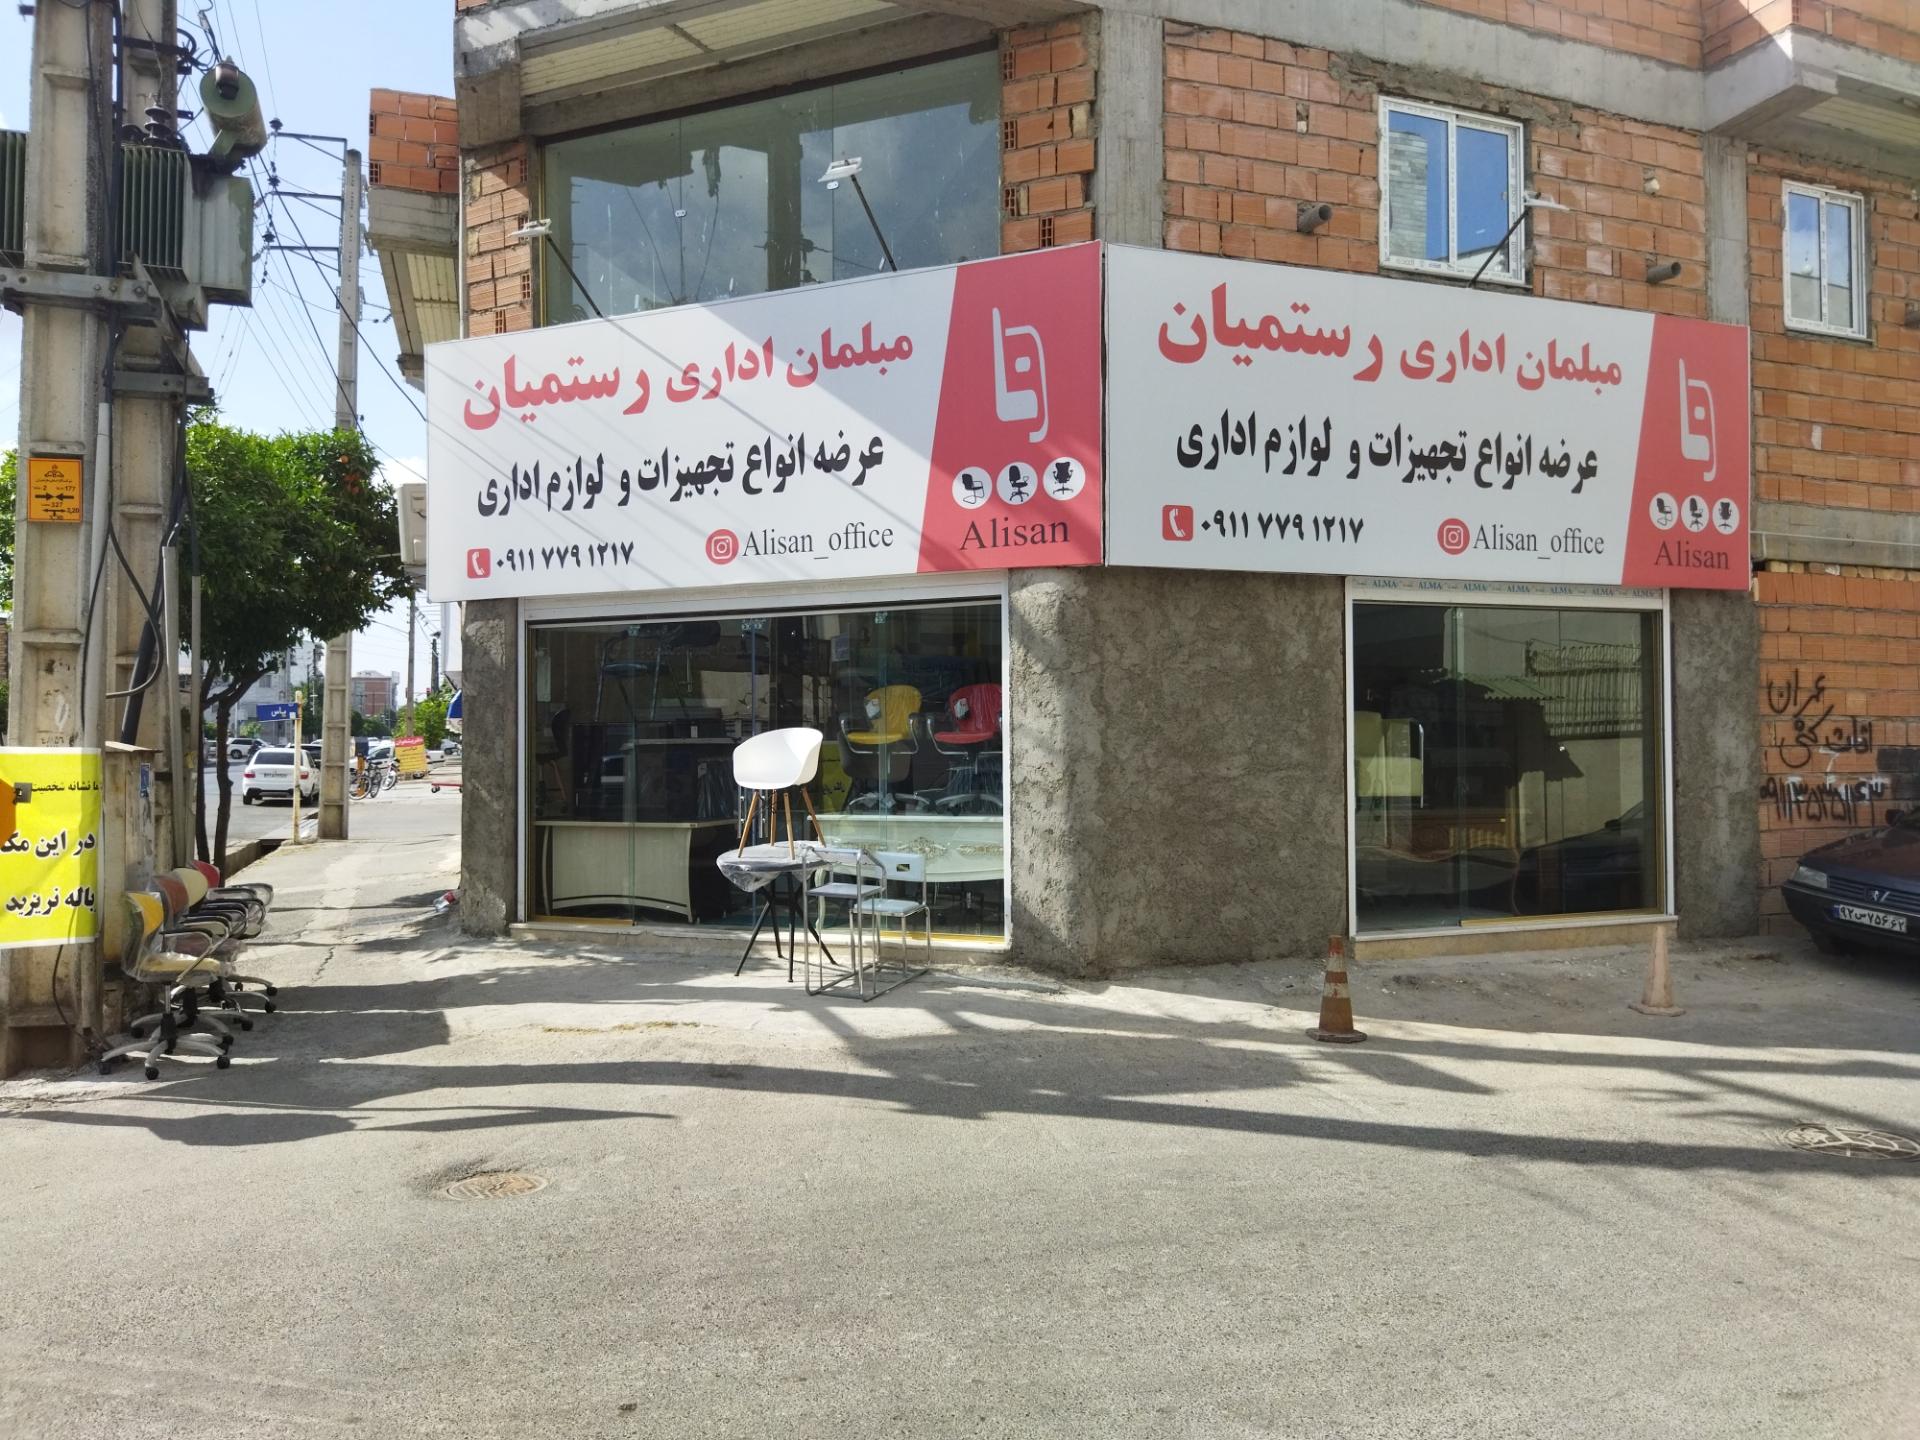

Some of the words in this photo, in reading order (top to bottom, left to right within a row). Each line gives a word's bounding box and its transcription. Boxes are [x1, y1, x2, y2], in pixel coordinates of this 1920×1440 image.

[786, 323, 913, 389] مبلمان
[1158, 282, 1384, 382] رستمیان
[1400, 329, 1505, 384] اداری
[463, 355, 651, 431] رستمیان
[665, 335, 774, 403] اداری
[1516, 339, 1621, 391] مبلمان
[742, 432, 805, 495] انواع
[813, 429, 884, 486] عرضه
[1176, 407, 1256, 471] اداری
[1264, 414, 1332, 477] لوازم
[1346, 438, 1361, 480] و
[1368, 422, 1468, 484] تجهیزات
[1474, 431, 1532, 490] انواع
[1538, 437, 1598, 494] عرضه
[477, 460, 540, 517] اداری
[546, 452, 604, 512] لوازم
[617, 468, 631, 507] و
[637, 441, 734, 502] تجهیزات
[742, 520, 894, 560] Alisan_office
[959, 517, 1070, 551] Alisan
[1472, 522, 1605, 560] Alisan_office
[1653, 540, 1730, 570] Alisan
[1767, 667, 1826, 719] عمران
[35, 830, 66, 858] این
[73, 833, 96, 856] در
[6, 887, 59, 916] نریزید
[65, 886, 97, 912] باله
